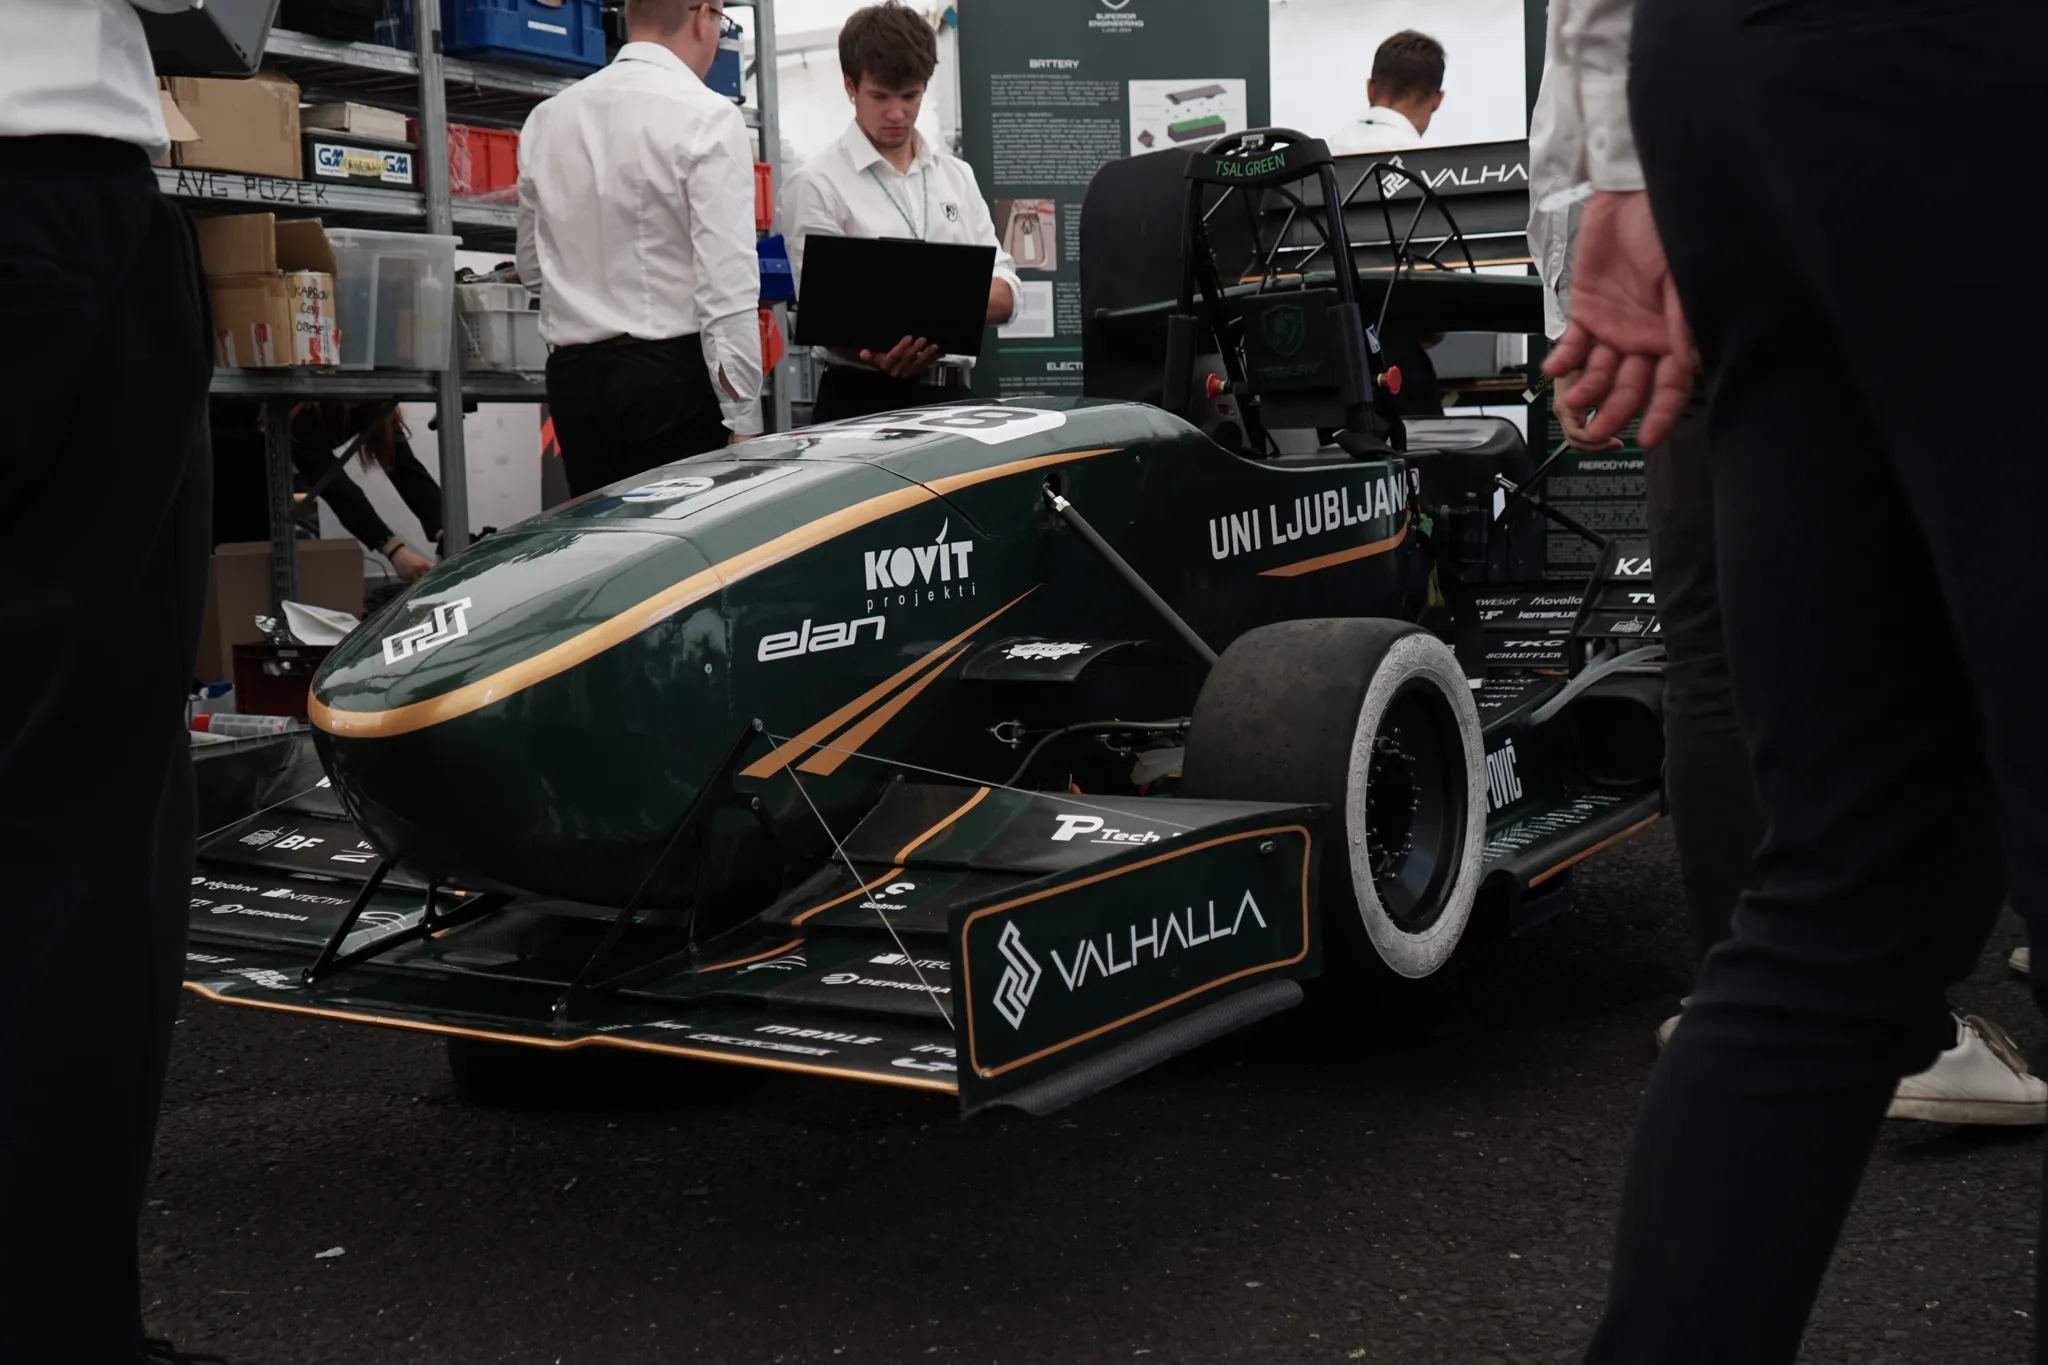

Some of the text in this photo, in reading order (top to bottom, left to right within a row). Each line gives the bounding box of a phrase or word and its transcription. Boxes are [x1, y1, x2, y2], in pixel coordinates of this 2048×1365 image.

[1029, 59, 1080, 69] BATTERY
[1215, 153, 1286, 177] TSAL GREEN
[1421, 162, 1529, 189] VALHA
[176, 171, 228, 198] AVG
[1209, 508, 1262, 560] UNI
[864, 517, 974, 592] KOVIT
[1614, 557, 1652, 576] KA
[867, 582, 976, 614] projekti
[1475, 595, 1583, 607] EWESoft Movella
[757, 615, 886, 662] elan
[1484, 651, 1562, 660] SCHAEFFLER
[859, 901, 908, 911] Slatnar
[1050, 889, 1268, 992] VALHALLA
[856, 978, 952, 995] DEPROMA
[753, 1024, 884, 1045] MAHLE
